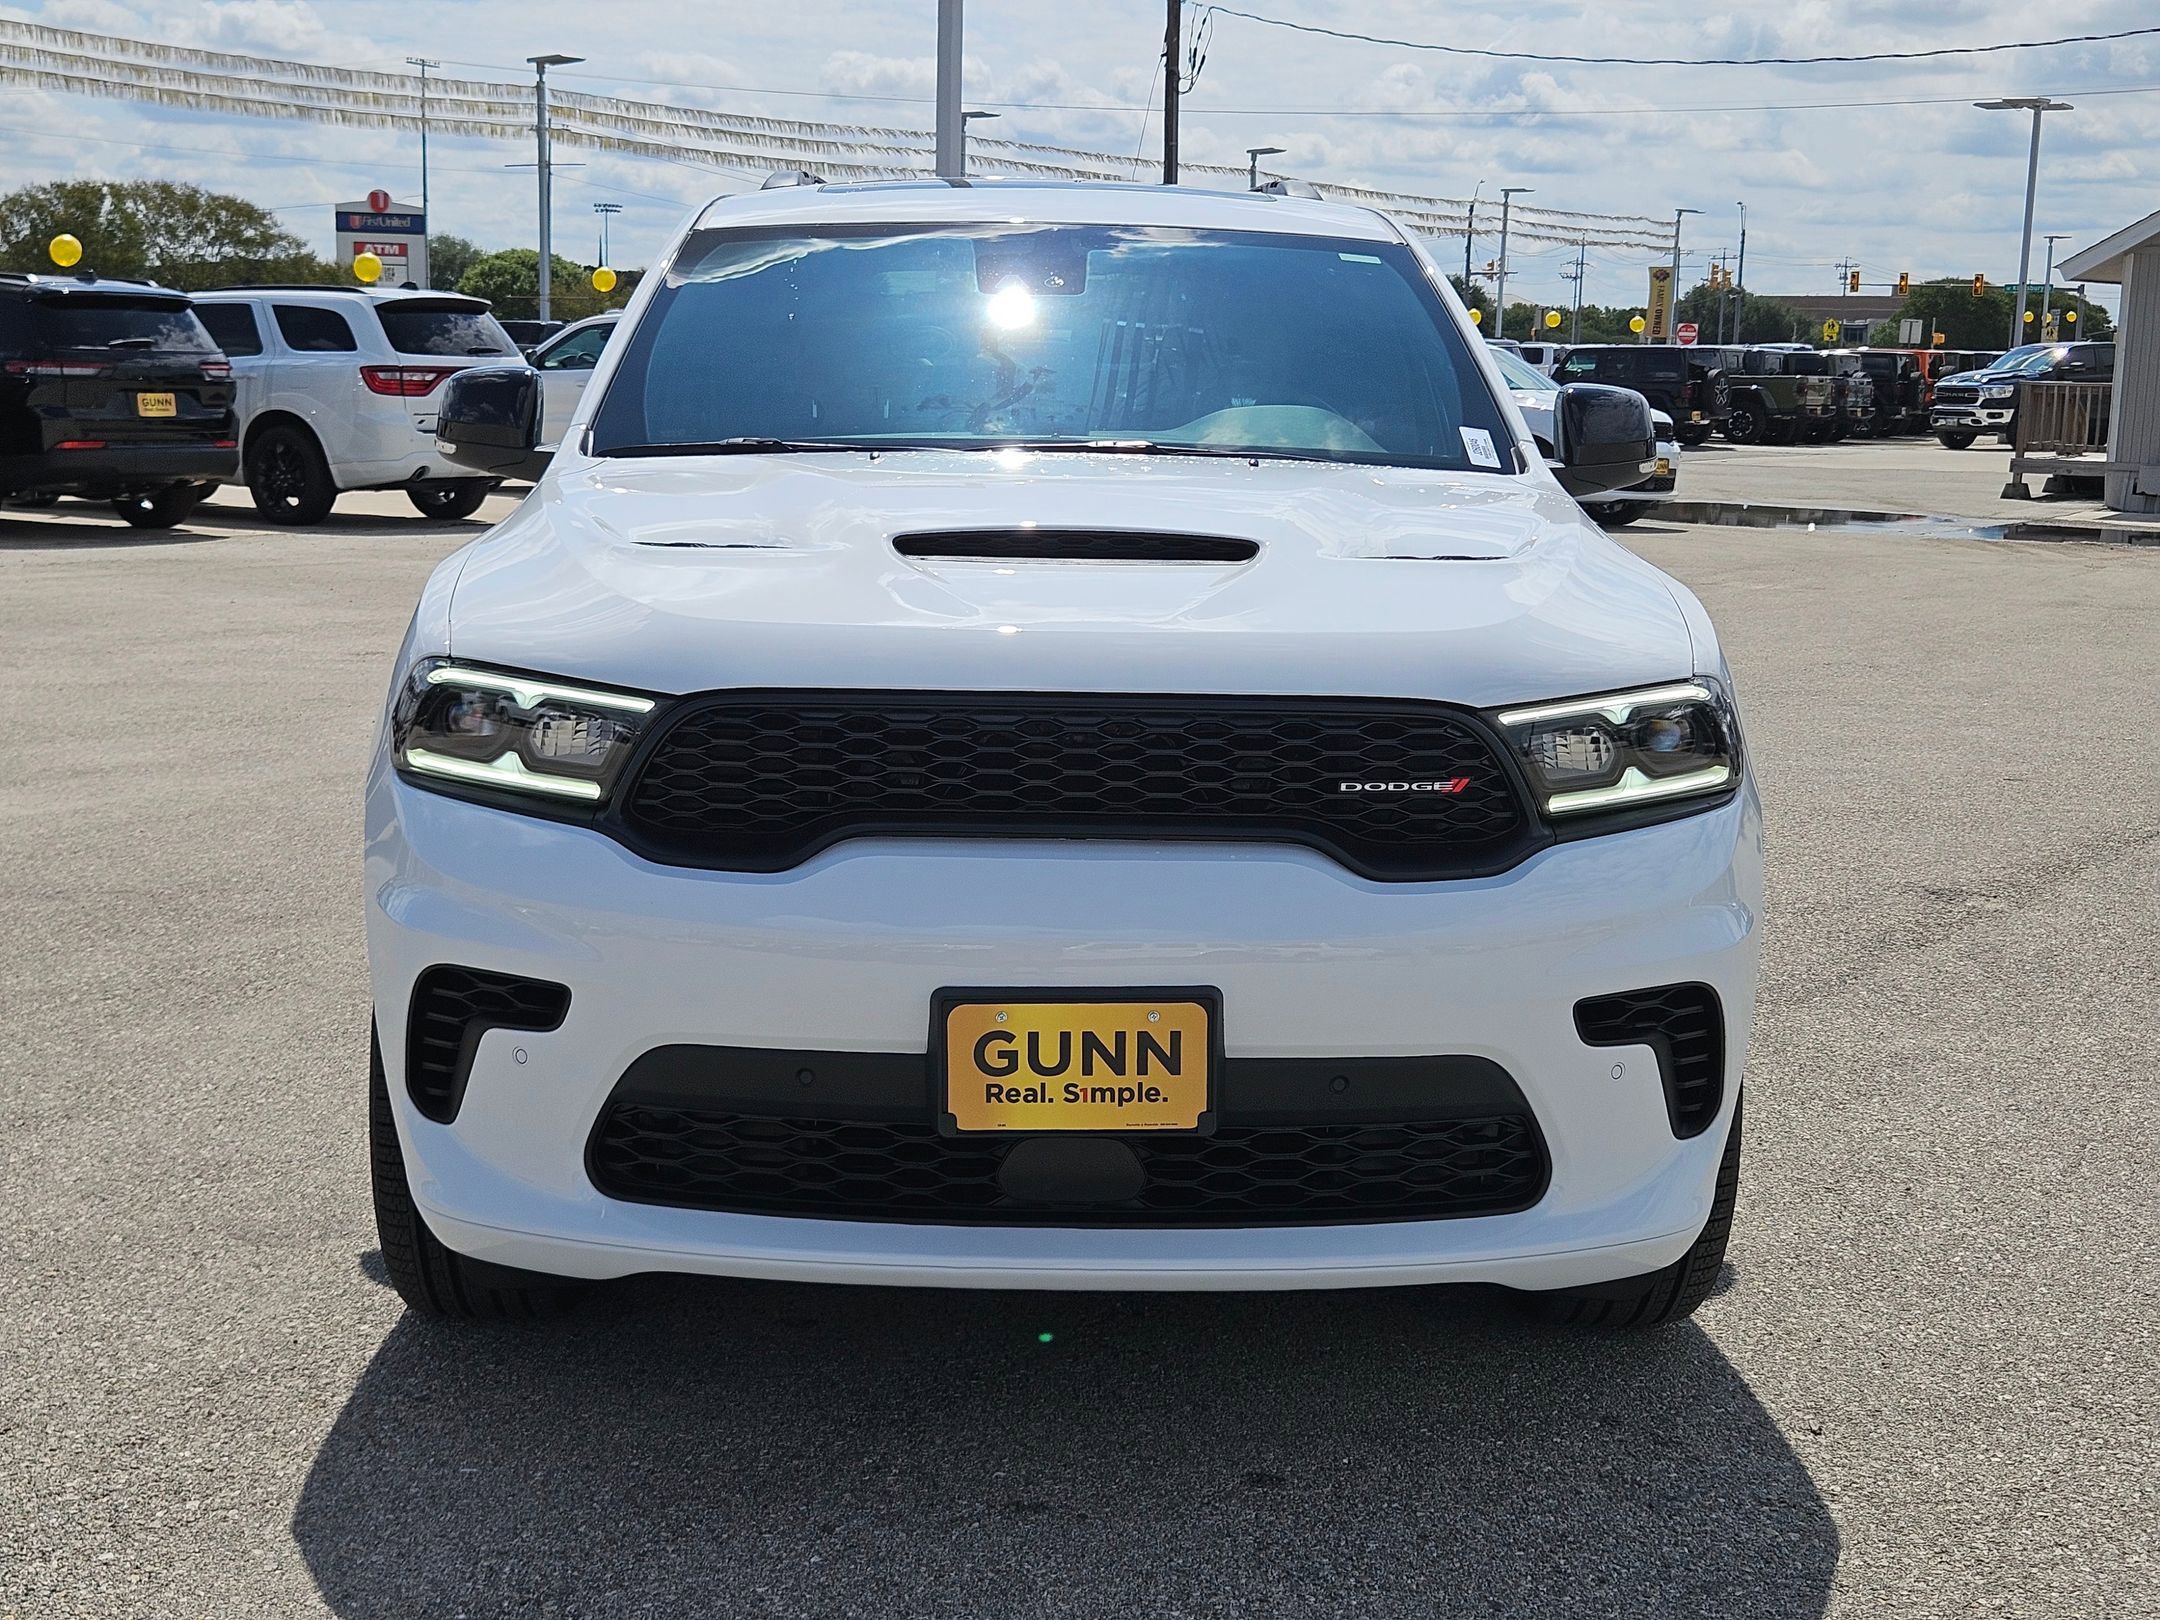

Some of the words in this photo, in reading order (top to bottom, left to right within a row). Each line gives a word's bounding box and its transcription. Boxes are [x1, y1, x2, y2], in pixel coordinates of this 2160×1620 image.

[364, 244, 400, 255] ATM
[1652, 308, 1664, 335] OWNED
[142, 398, 172, 407] GUNN
[1340, 781, 1455, 792] DODGE
[973, 1030, 1182, 1077] GUNN
[985, 1082, 1054, 1104] Real.
